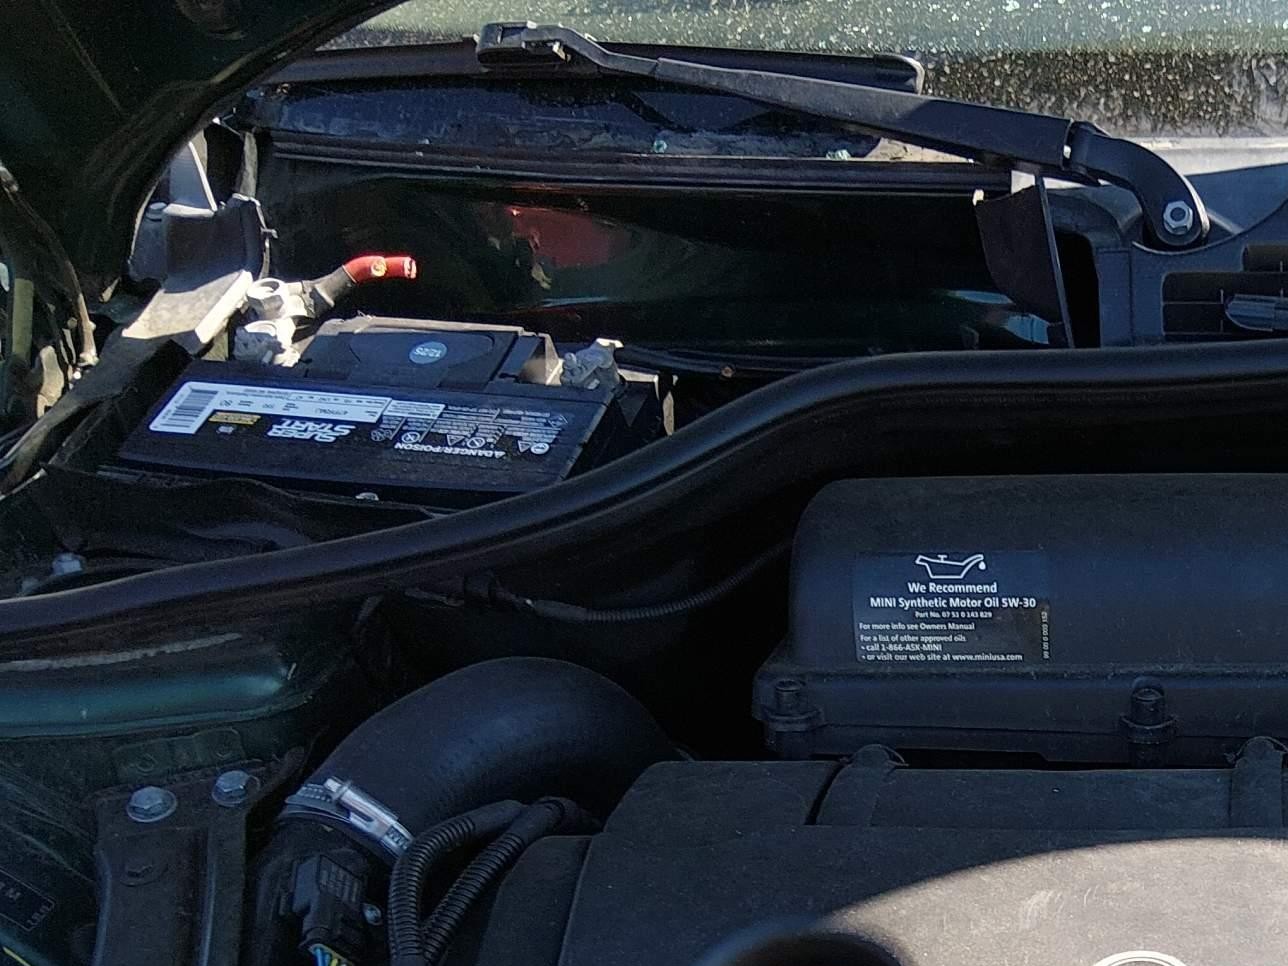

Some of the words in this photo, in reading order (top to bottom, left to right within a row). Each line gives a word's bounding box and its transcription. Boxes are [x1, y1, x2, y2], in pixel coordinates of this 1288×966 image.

[267, 425, 336, 443] SUPER
[280, 418, 357, 436] START
[394, 442, 494, 457] DANGER/POISON
[907, 582, 927, 593] We
[929, 582, 998, 593] Recommend
[870, 597, 896, 608] MINI
[898, 597, 947, 610] Synthetic
[949, 597, 982, 608] Motor
[984, 597, 999, 608] Oil
[1002, 597, 1037, 608] 5W-30
[920, 635, 952, 643] approved
